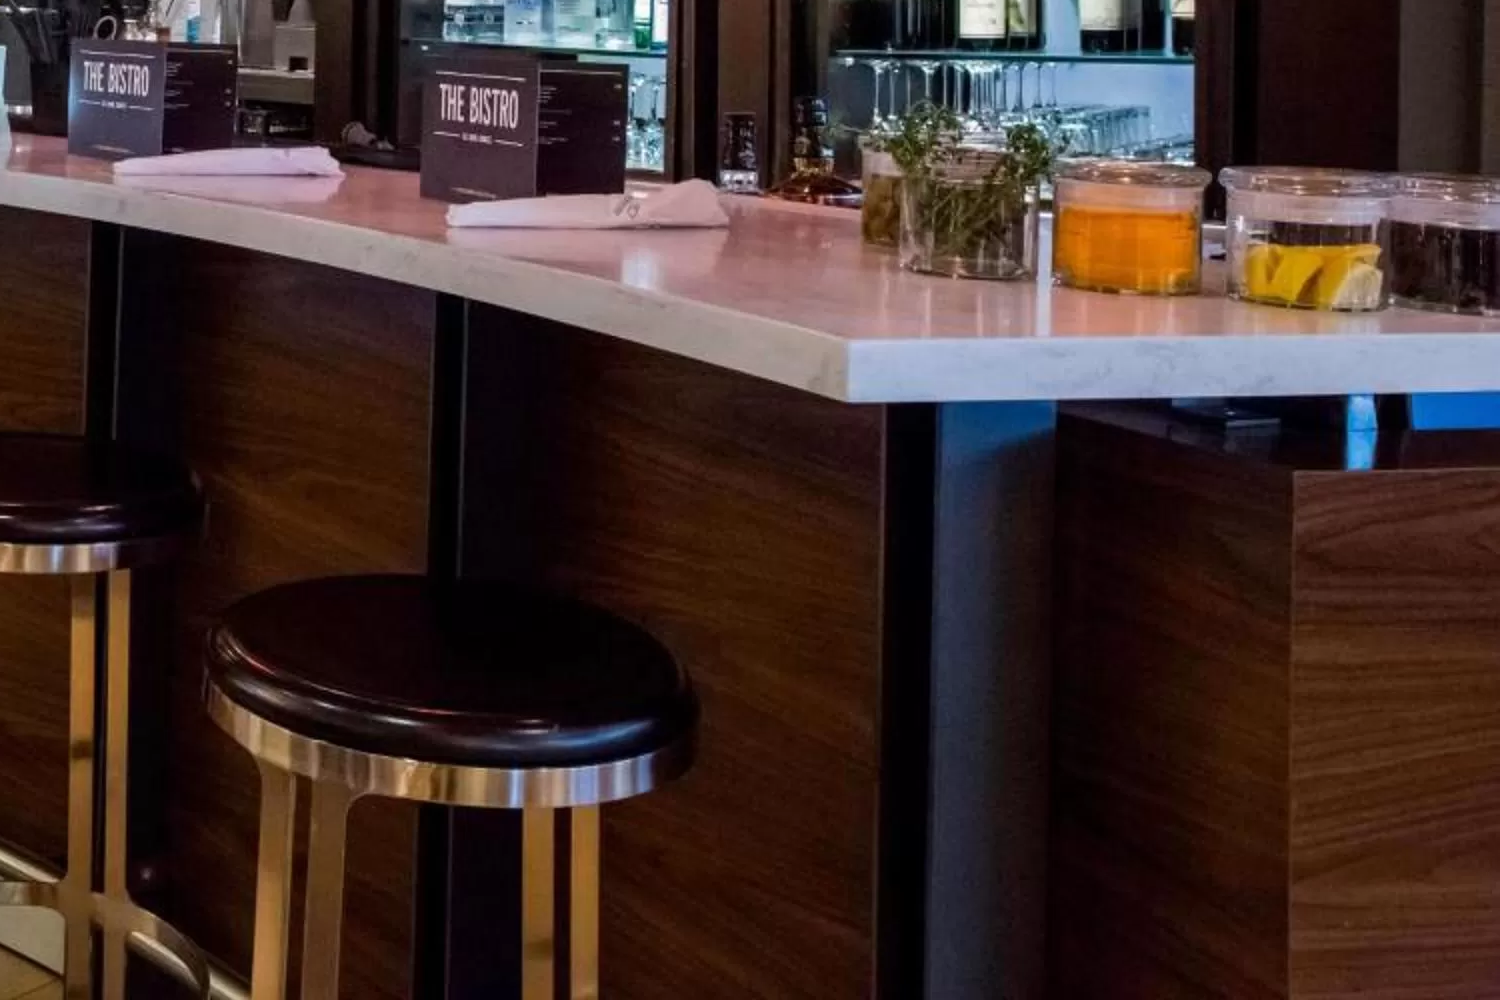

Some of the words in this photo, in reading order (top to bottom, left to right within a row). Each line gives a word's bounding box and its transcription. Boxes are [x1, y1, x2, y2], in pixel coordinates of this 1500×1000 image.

[83, 60, 105, 93] THE
[107, 62, 150, 98] BISTRO
[439, 83, 465, 122] THE
[469, 86, 520, 130] BISTRO
